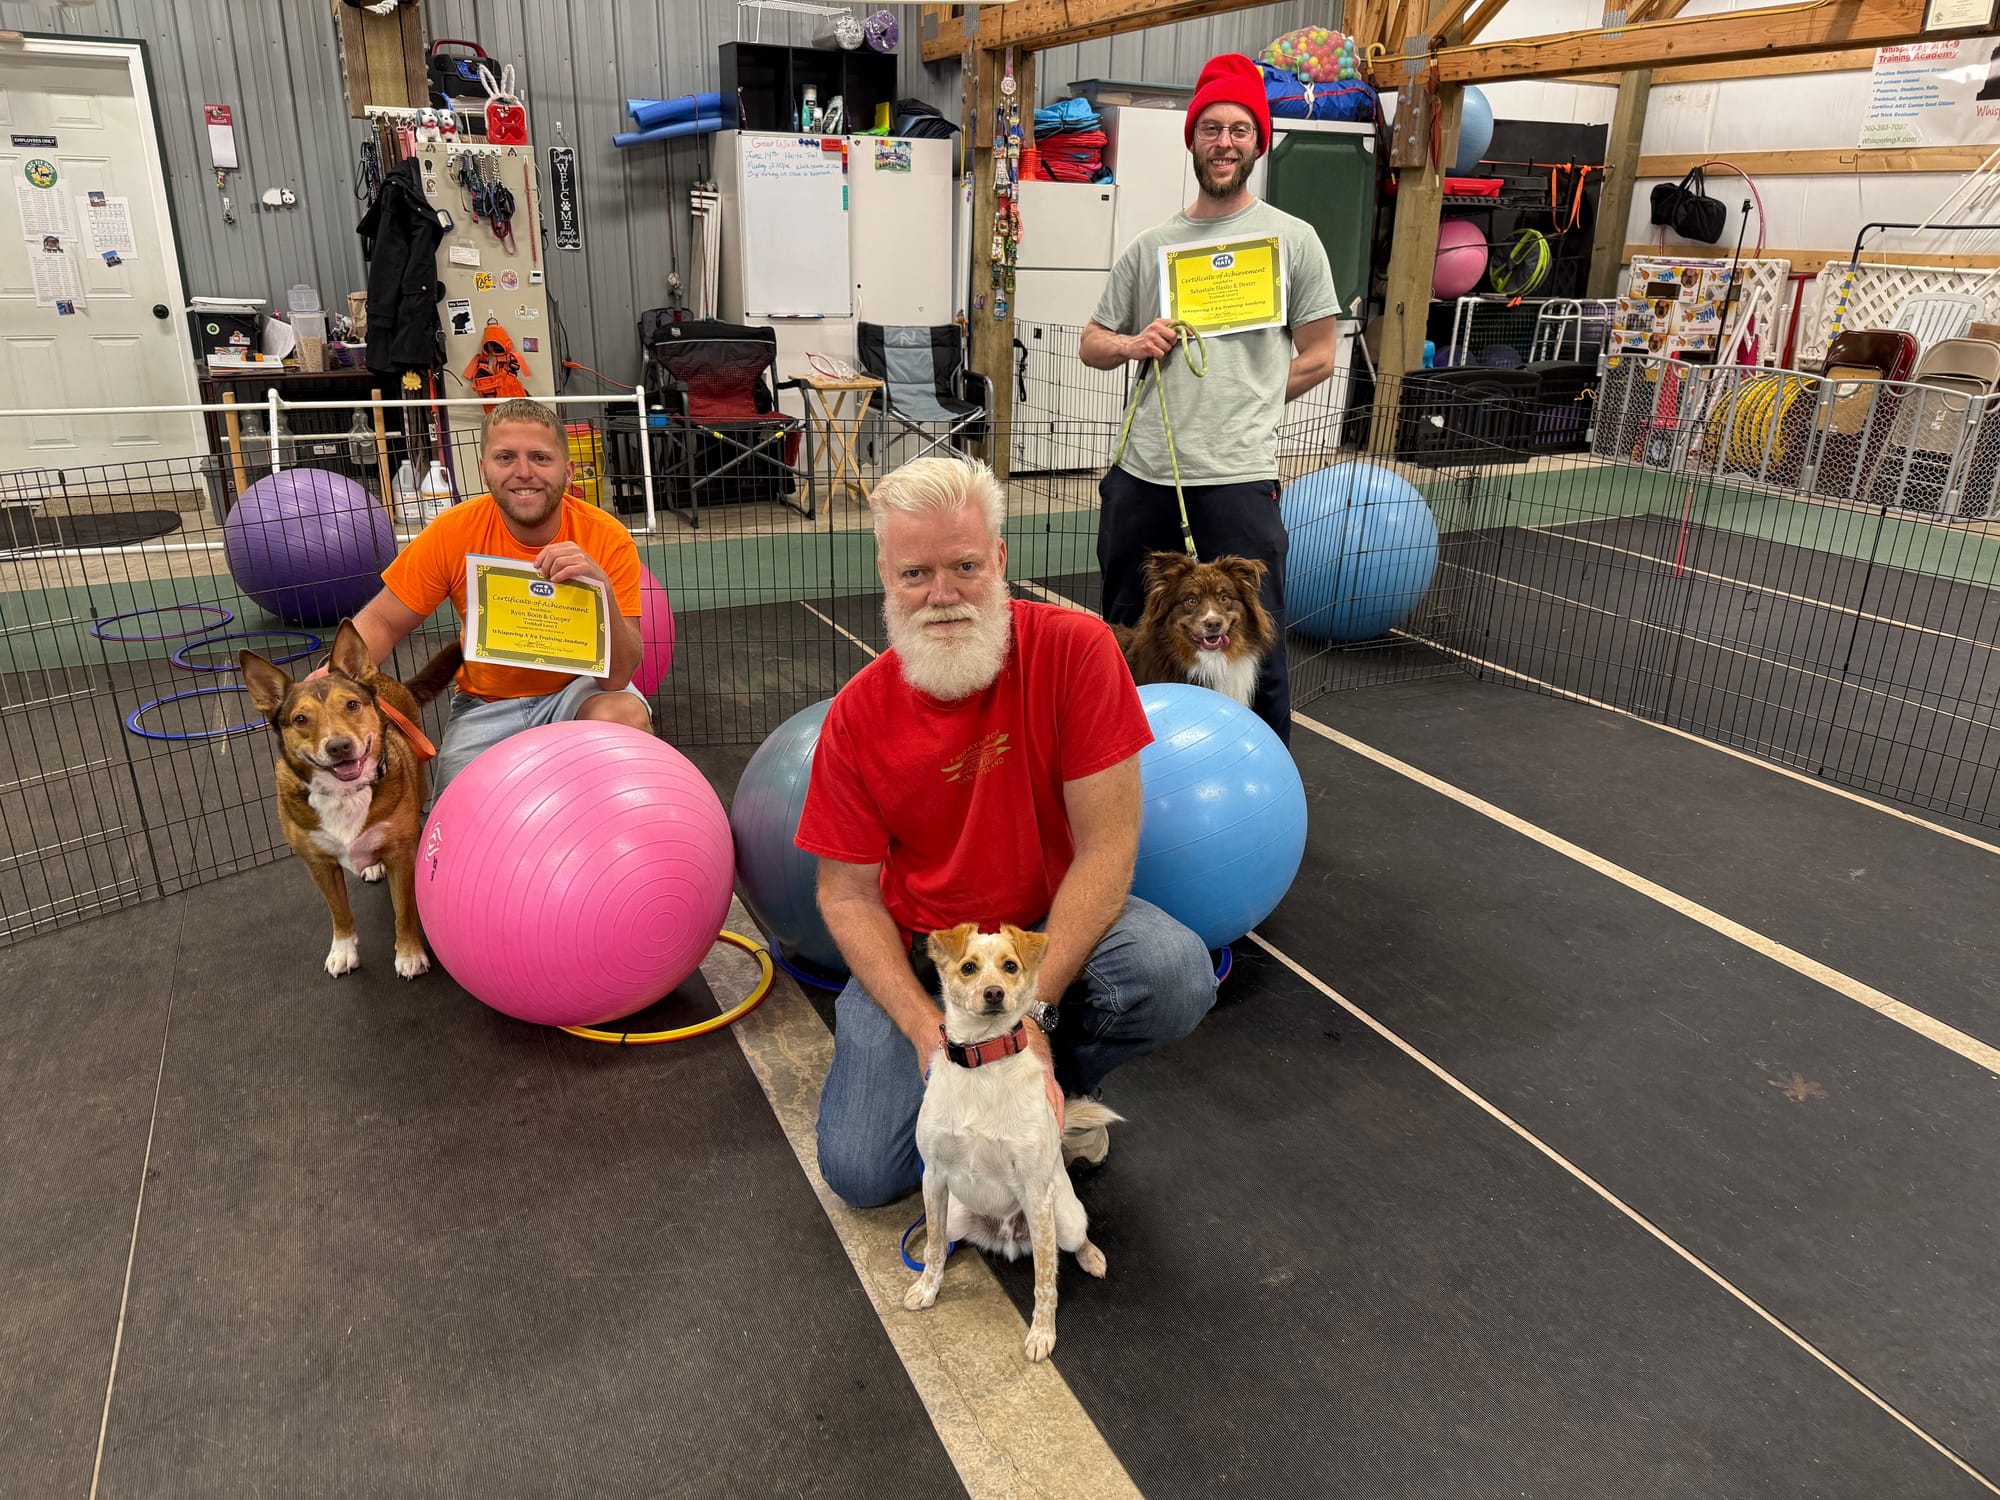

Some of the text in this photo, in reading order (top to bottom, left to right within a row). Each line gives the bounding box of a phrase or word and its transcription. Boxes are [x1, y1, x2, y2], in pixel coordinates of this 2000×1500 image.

[1879, 50, 1958, 64] Training Academy
[1181, 266, 1266, 285] Certificate of Achievement
[492, 594, 589, 613] Certificate of Achievement
[510, 609, 526, 617] Ryan
[492, 628, 524, 638] Whispering
[539, 634, 562, 643] Training
[563, 638, 588, 646] Academy
